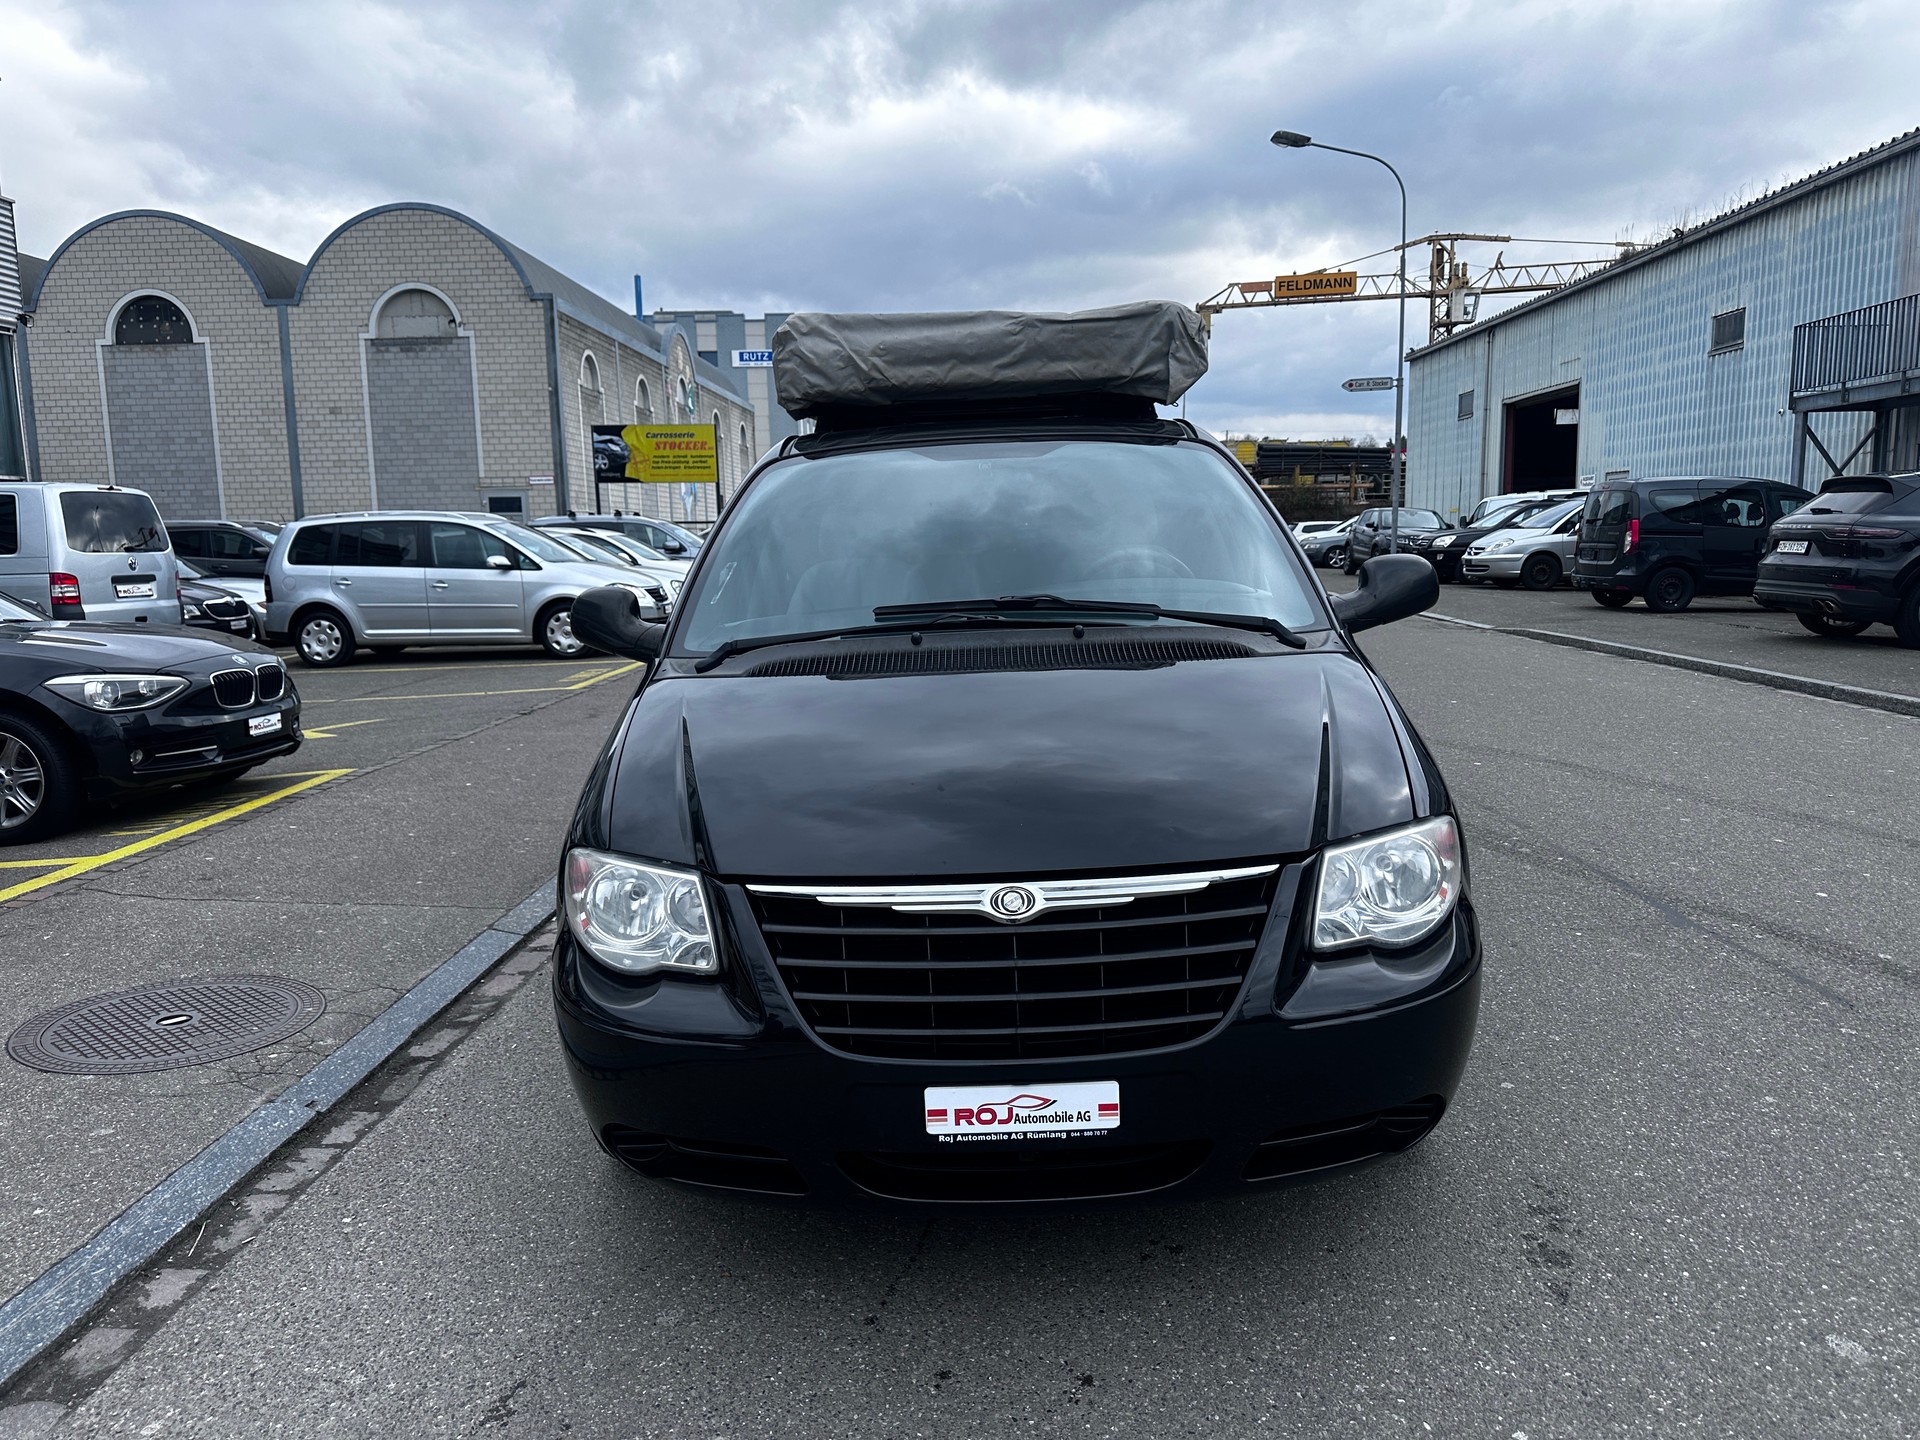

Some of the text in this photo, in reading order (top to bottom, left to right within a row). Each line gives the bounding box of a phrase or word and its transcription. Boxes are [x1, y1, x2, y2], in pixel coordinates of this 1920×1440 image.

[1279, 277, 1352, 291] FELDMANN
[743, 352, 769, 361] RUTZ
[645, 431, 695, 439] Carrosserie
[655, 440, 707, 451] STOCKER
[954, 1106, 1091, 1127] ROJ Automobile AG
[938, 1133, 954, 1143] Roj
[956, 1133, 1009, 1142] Automobile
[1010, 1132, 1024, 1140] AG
[1026, 1131, 1067, 1140] Rümlang
